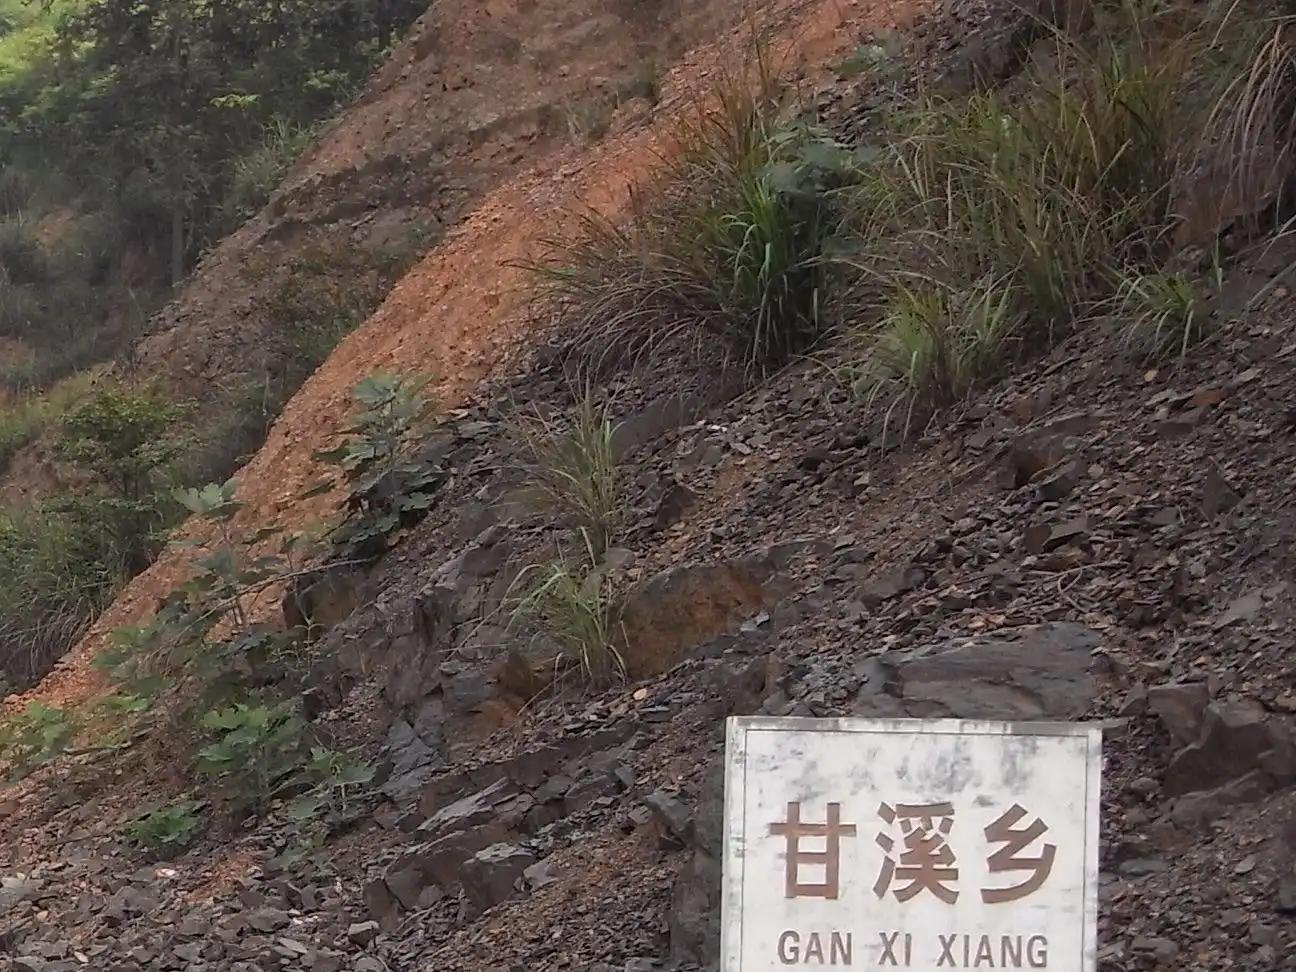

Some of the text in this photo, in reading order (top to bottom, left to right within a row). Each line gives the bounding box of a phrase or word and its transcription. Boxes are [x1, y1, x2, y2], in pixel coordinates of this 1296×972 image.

[770, 800, 1057, 906] 甘溪乡
[776, 930, 1050, 969] GAN XI XIANG
